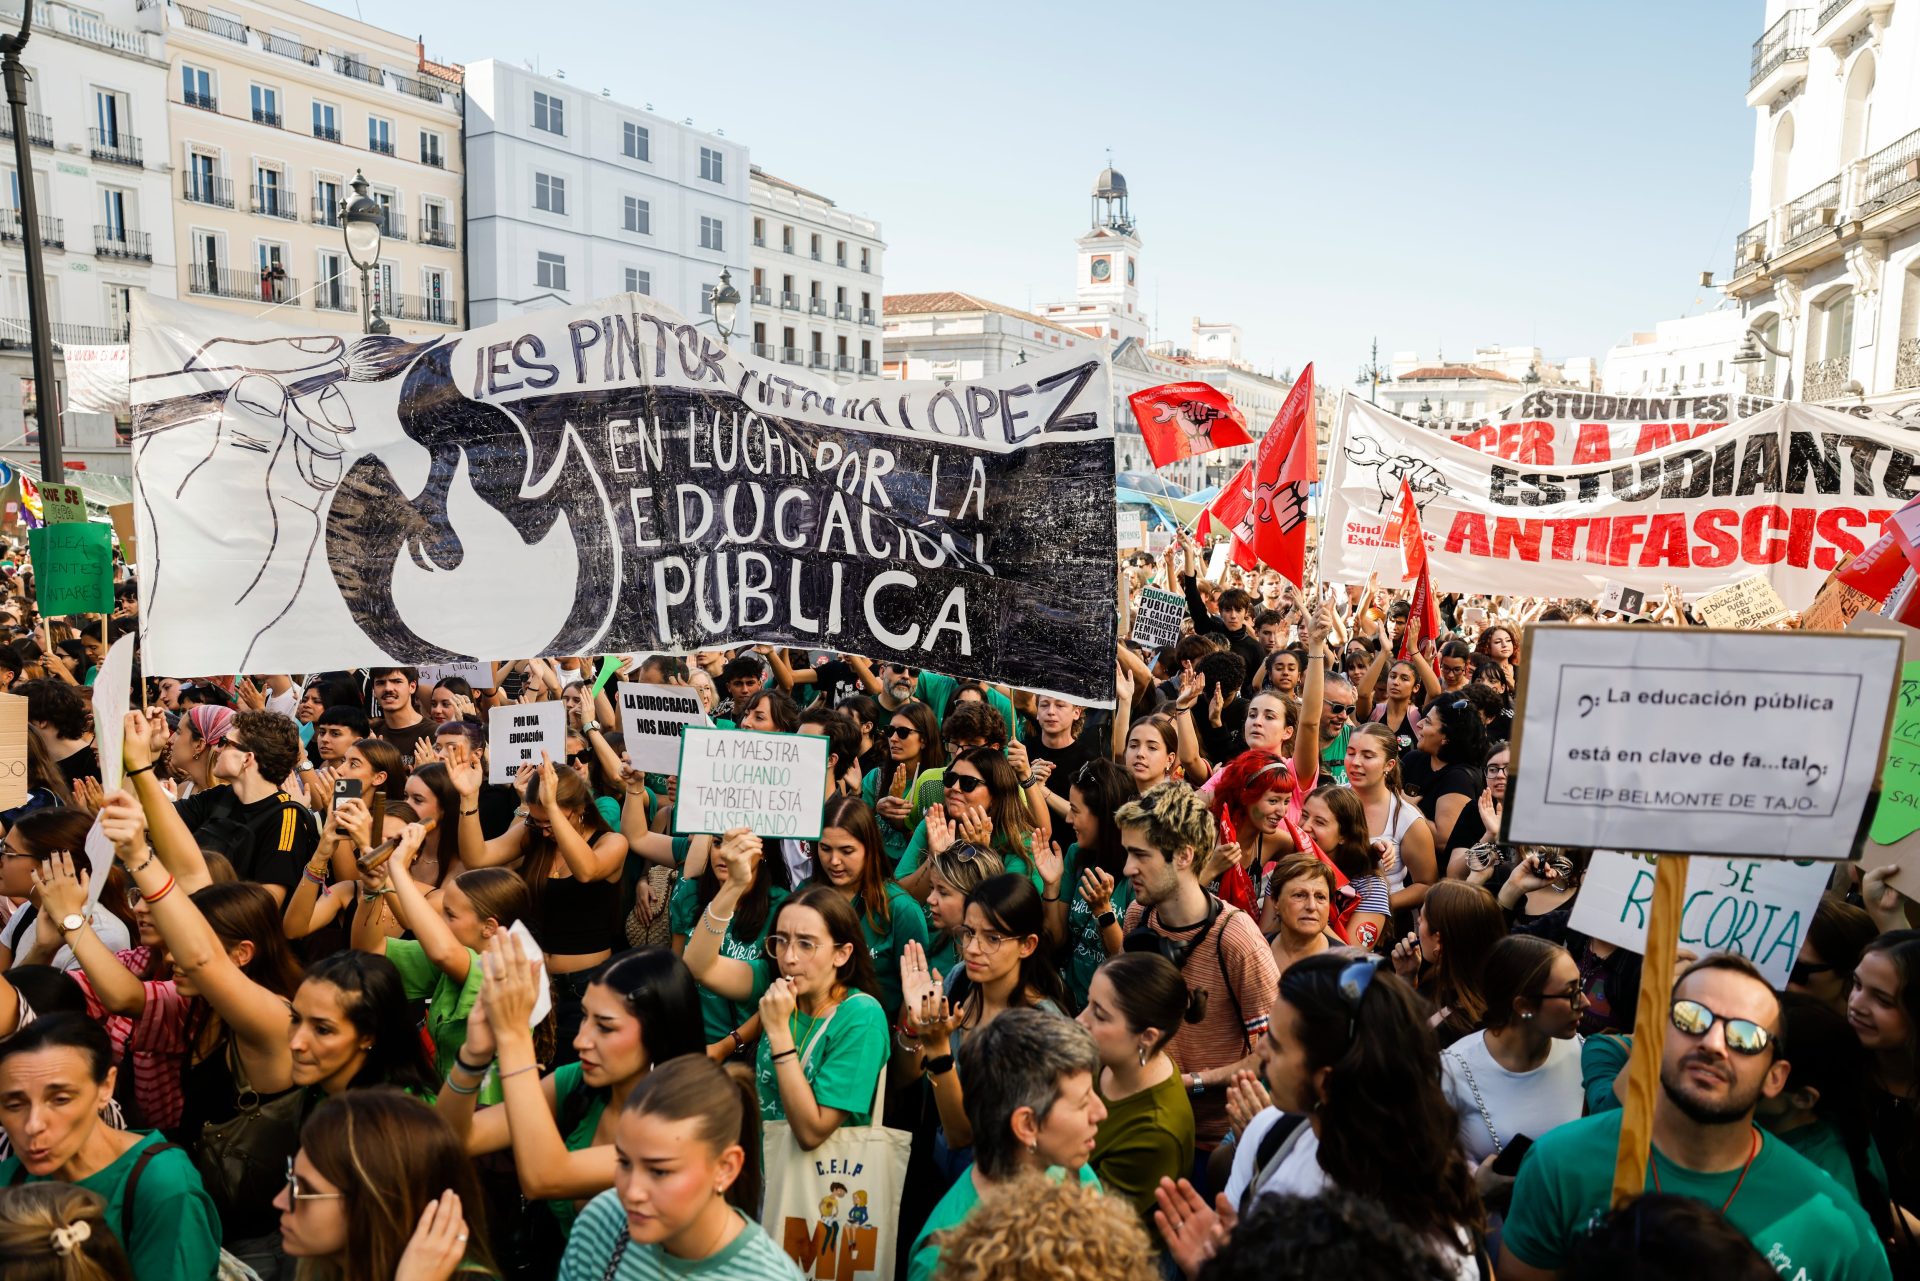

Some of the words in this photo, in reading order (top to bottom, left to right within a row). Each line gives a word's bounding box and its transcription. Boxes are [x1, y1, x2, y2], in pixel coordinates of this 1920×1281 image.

[473, 334, 559, 399] IES
[1522, 390, 1729, 421] ESTUDIANTES
[608, 415, 663, 474] EN
[928, 455, 986, 521] LA
[654, 533, 972, 657] PÚBLICA
[1150, 610, 1181, 626] CALIDAD
[1134, 623, 1178, 642] FEMINISTA
[624, 694, 636, 709] LA
[637, 695, 700, 715] BUROCRACIA
[1607, 688, 1631, 703] La
[1638, 689, 1747, 707] educación
[1753, 692, 1834, 712] pública
[513, 716, 525, 727] POR
[526, 715, 539, 726] UNA
[637, 718, 656, 735] NOS
[658, 721, 689, 737] AHOG
[509, 730, 544, 744] EDUCACIÓN
[520, 749, 532, 760] SIN
[706, 738, 726, 759] LA
[733, 740, 800, 763] MAESTRA
[1568, 746, 1611, 762] está
[1617, 749, 1643, 763] en
[1649, 748, 1702, 765] clave
[1709, 751, 1735, 767] de
[712, 763, 791, 786] LUCHANDO
[696, 786, 762, 810] TAMBIÉN
[769, 788, 802, 812] ESTÁ
[1619, 788, 1724, 807] BELMONTE
[1729, 793, 1755, 808] DE
[704, 810, 798, 835] ENSEÑANDO
[1620, 870, 1801, 972] RCORTA
